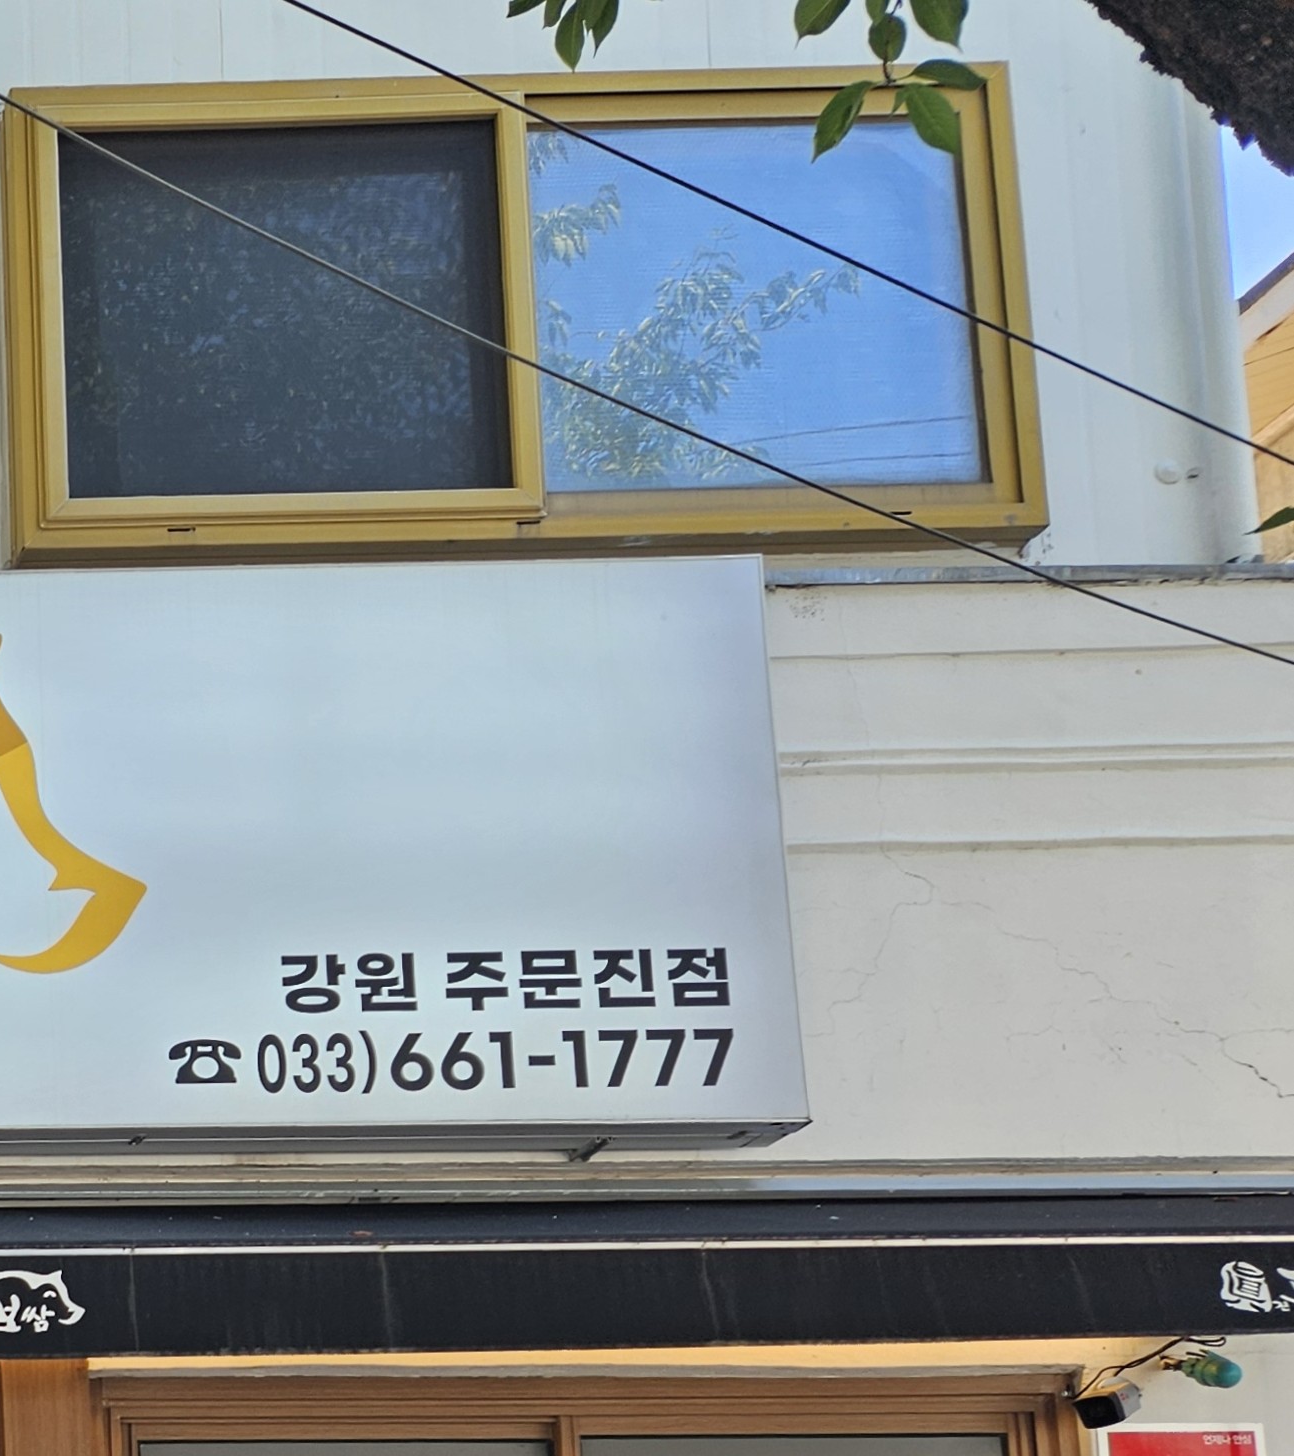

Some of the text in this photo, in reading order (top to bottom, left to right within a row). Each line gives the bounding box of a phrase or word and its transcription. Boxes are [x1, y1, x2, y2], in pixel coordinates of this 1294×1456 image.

[280, 946, 729, 1011] 강원 주문진점
[256, 1027, 734, 1096] 033)661-1777
